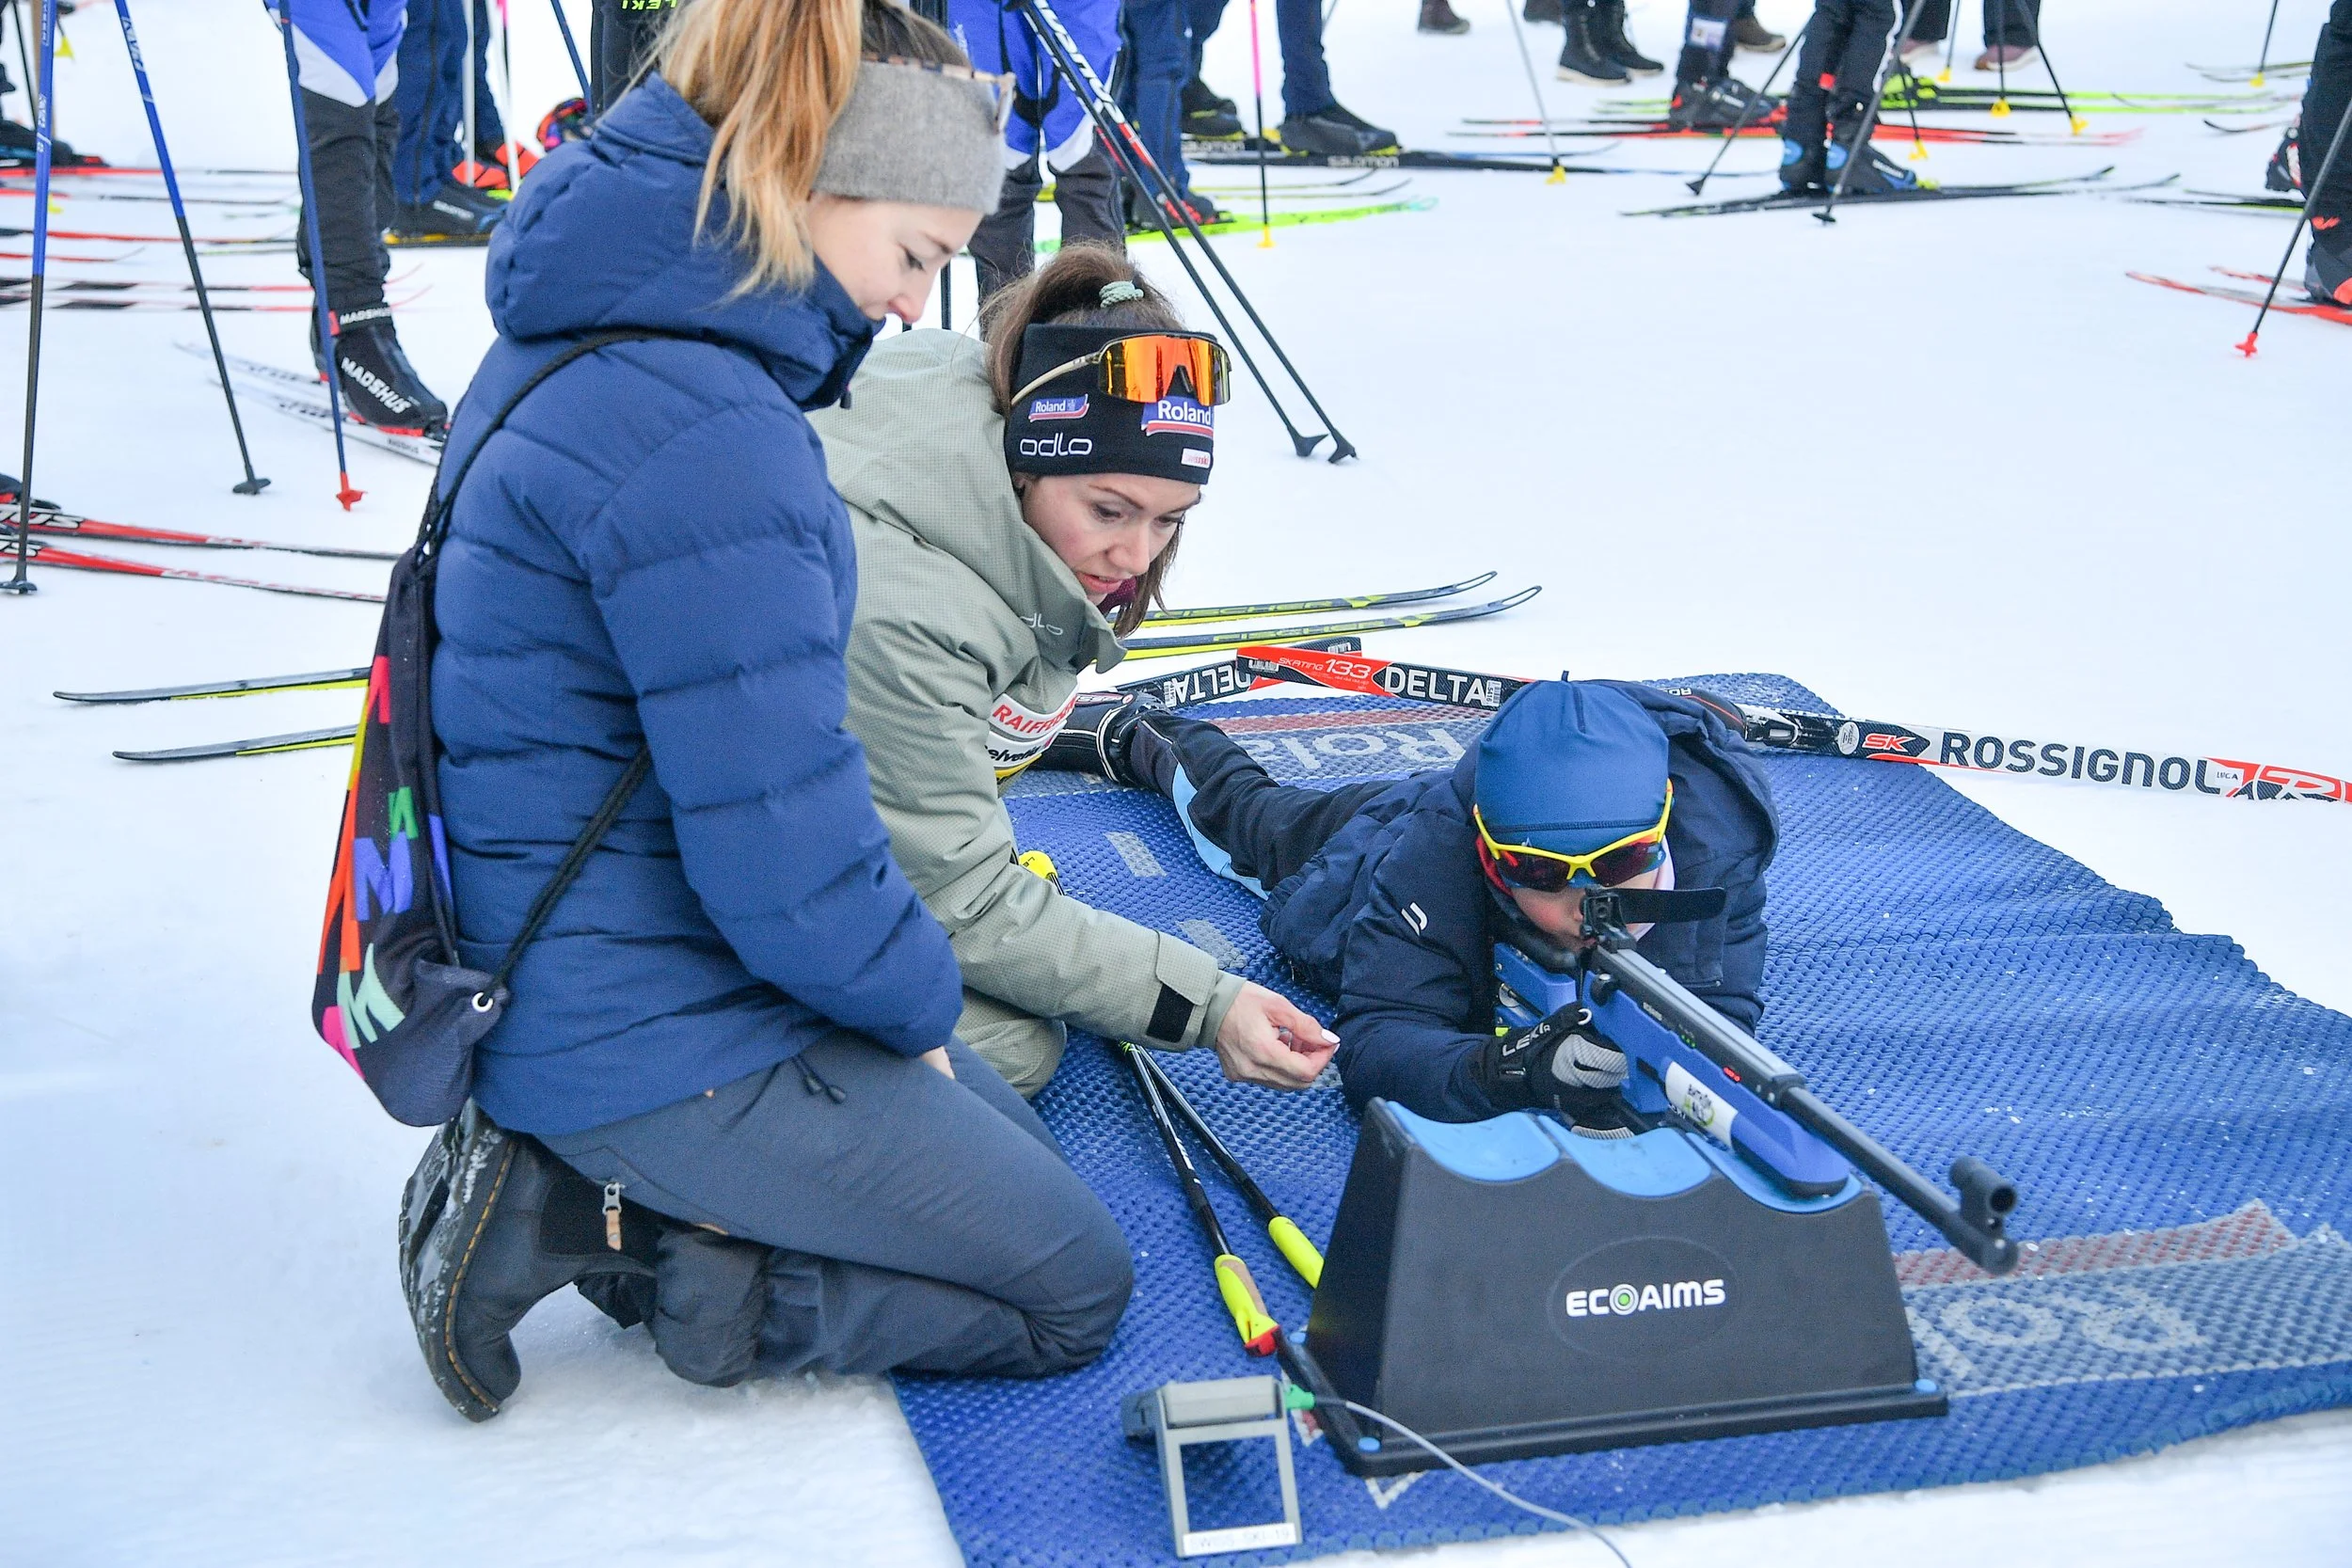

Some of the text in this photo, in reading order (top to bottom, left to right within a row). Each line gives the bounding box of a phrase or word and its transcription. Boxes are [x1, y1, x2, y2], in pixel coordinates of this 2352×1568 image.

[341, 356, 412, 414] MADSHUS
[1036, 401, 1066, 413] Roland
[1157, 400, 1212, 425] Roland
[1020, 433, 1092, 457] odlo
[1020, 613, 1063, 635] dlo
[1278, 657, 1372, 680] SKATING 133
[1384, 666, 1488, 706] DELTA
[1862, 732, 1913, 752] SK
[1939, 730, 2221, 796] ROSSIGNOL
[2216, 771, 2239, 781] LUCA
[1565, 1278, 1726, 1318] ECOAIMS
